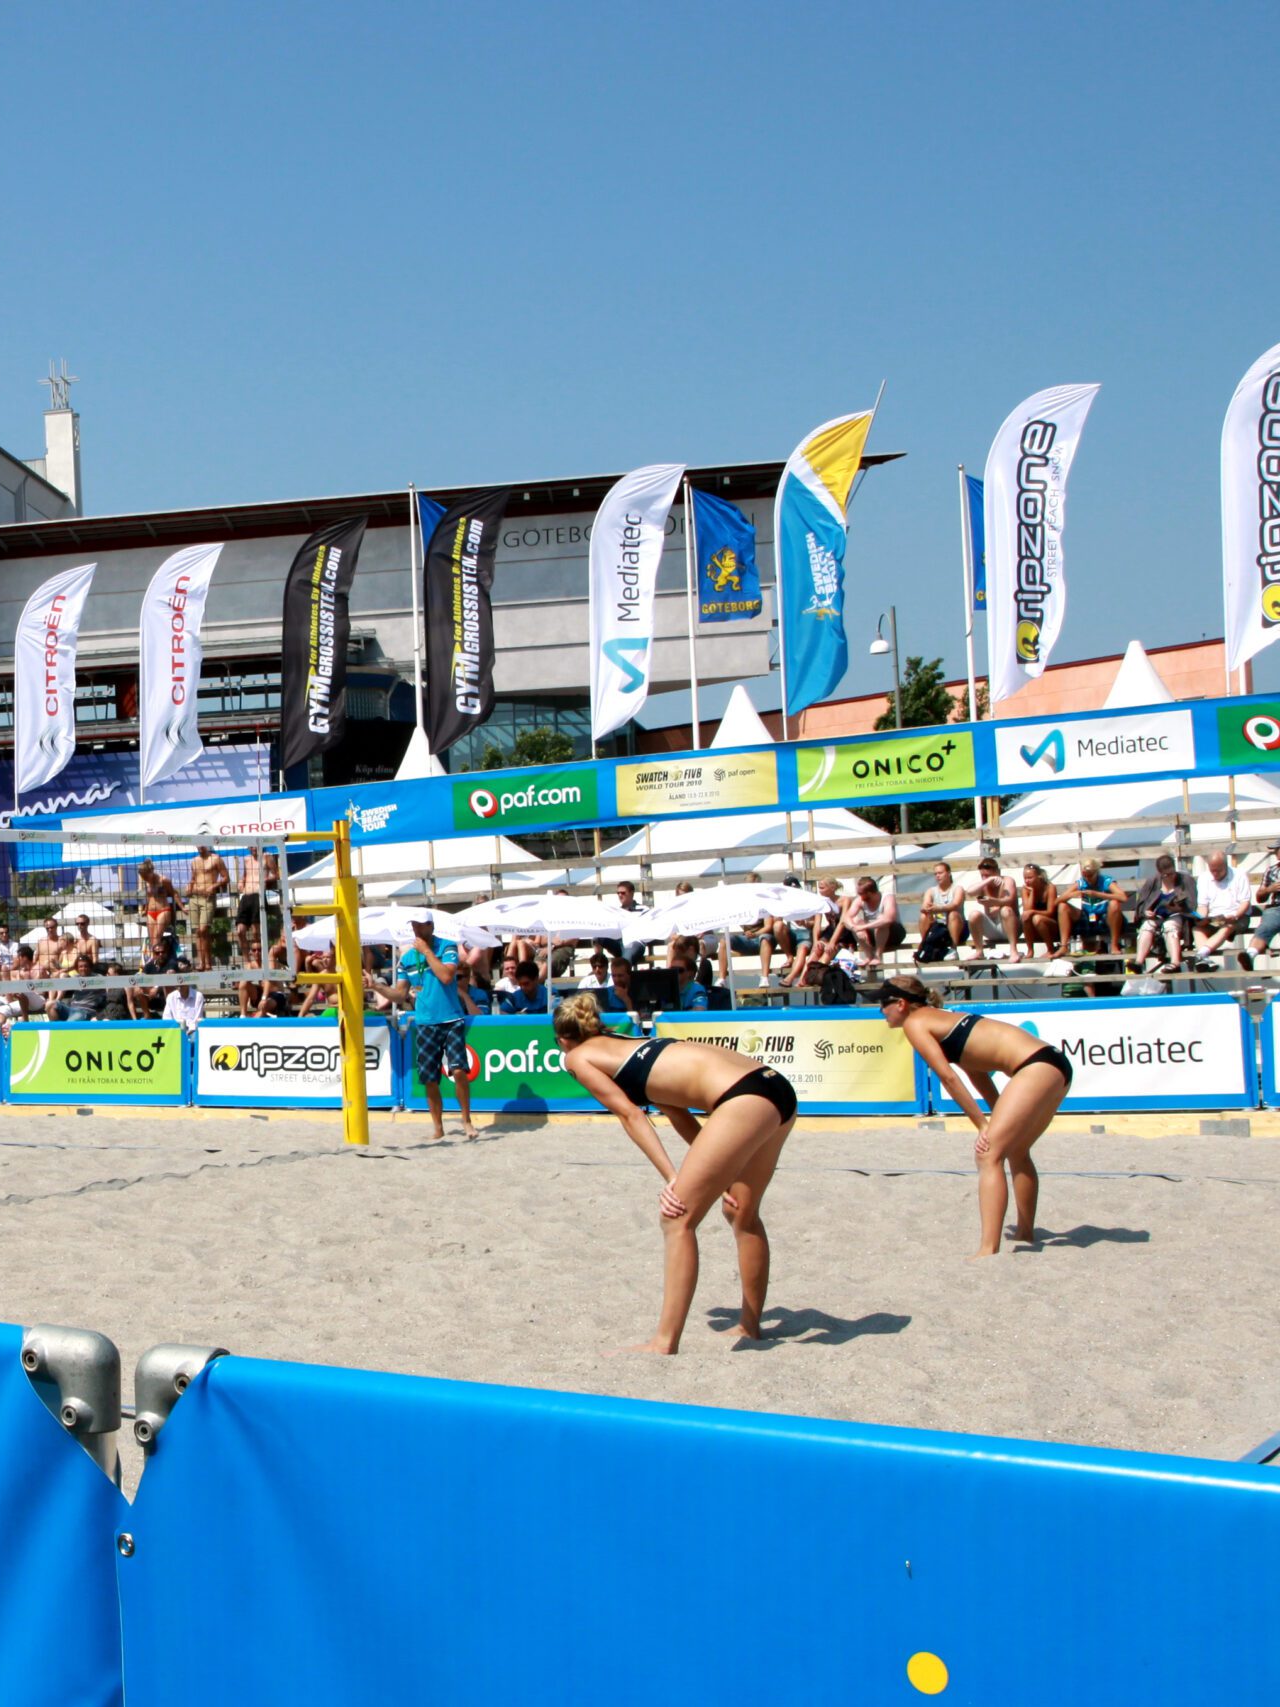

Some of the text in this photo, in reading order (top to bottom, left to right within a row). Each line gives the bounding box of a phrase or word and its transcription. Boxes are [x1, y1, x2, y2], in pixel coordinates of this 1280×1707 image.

[1046, 446, 1064, 578] STREET BEACH SNOW
[617, 513, 642, 622] Mediatec
[805, 531, 825, 595] SWEDISH
[701, 599, 760, 615] GÖTEBORG
[455, 518, 485, 716] GYMGROSSISTEN.com
[308, 546, 342, 734] GYMGROSSISTEN.com
[453, 627, 463, 642] For
[308, 652, 317, 665] For
[1077, 734, 1169, 758] Mediatec
[635, 767, 703, 785] SWATCH FIVB
[727, 768, 756, 778] paf open
[635, 783, 663, 791] WORLD
[664, 781, 685, 789] TOUR
[500, 784, 581, 815] paf.com
[360, 803, 398, 819] SWEDISH
[361, 812, 390, 825] BEACH
[362, 820, 387, 833] TOUR
[765, 1036, 795, 1052] FIVB
[838, 1043, 884, 1055] paf open
[1061, 1036, 1204, 1066] Mediatec
[484, 1040, 567, 1082] paf.c
[767, 1054, 794, 1064] 2010
[79, 1075, 96, 1084] FRÅN
[271, 1073, 298, 1082] STREET
[302, 1074, 332, 1083] BEACH
